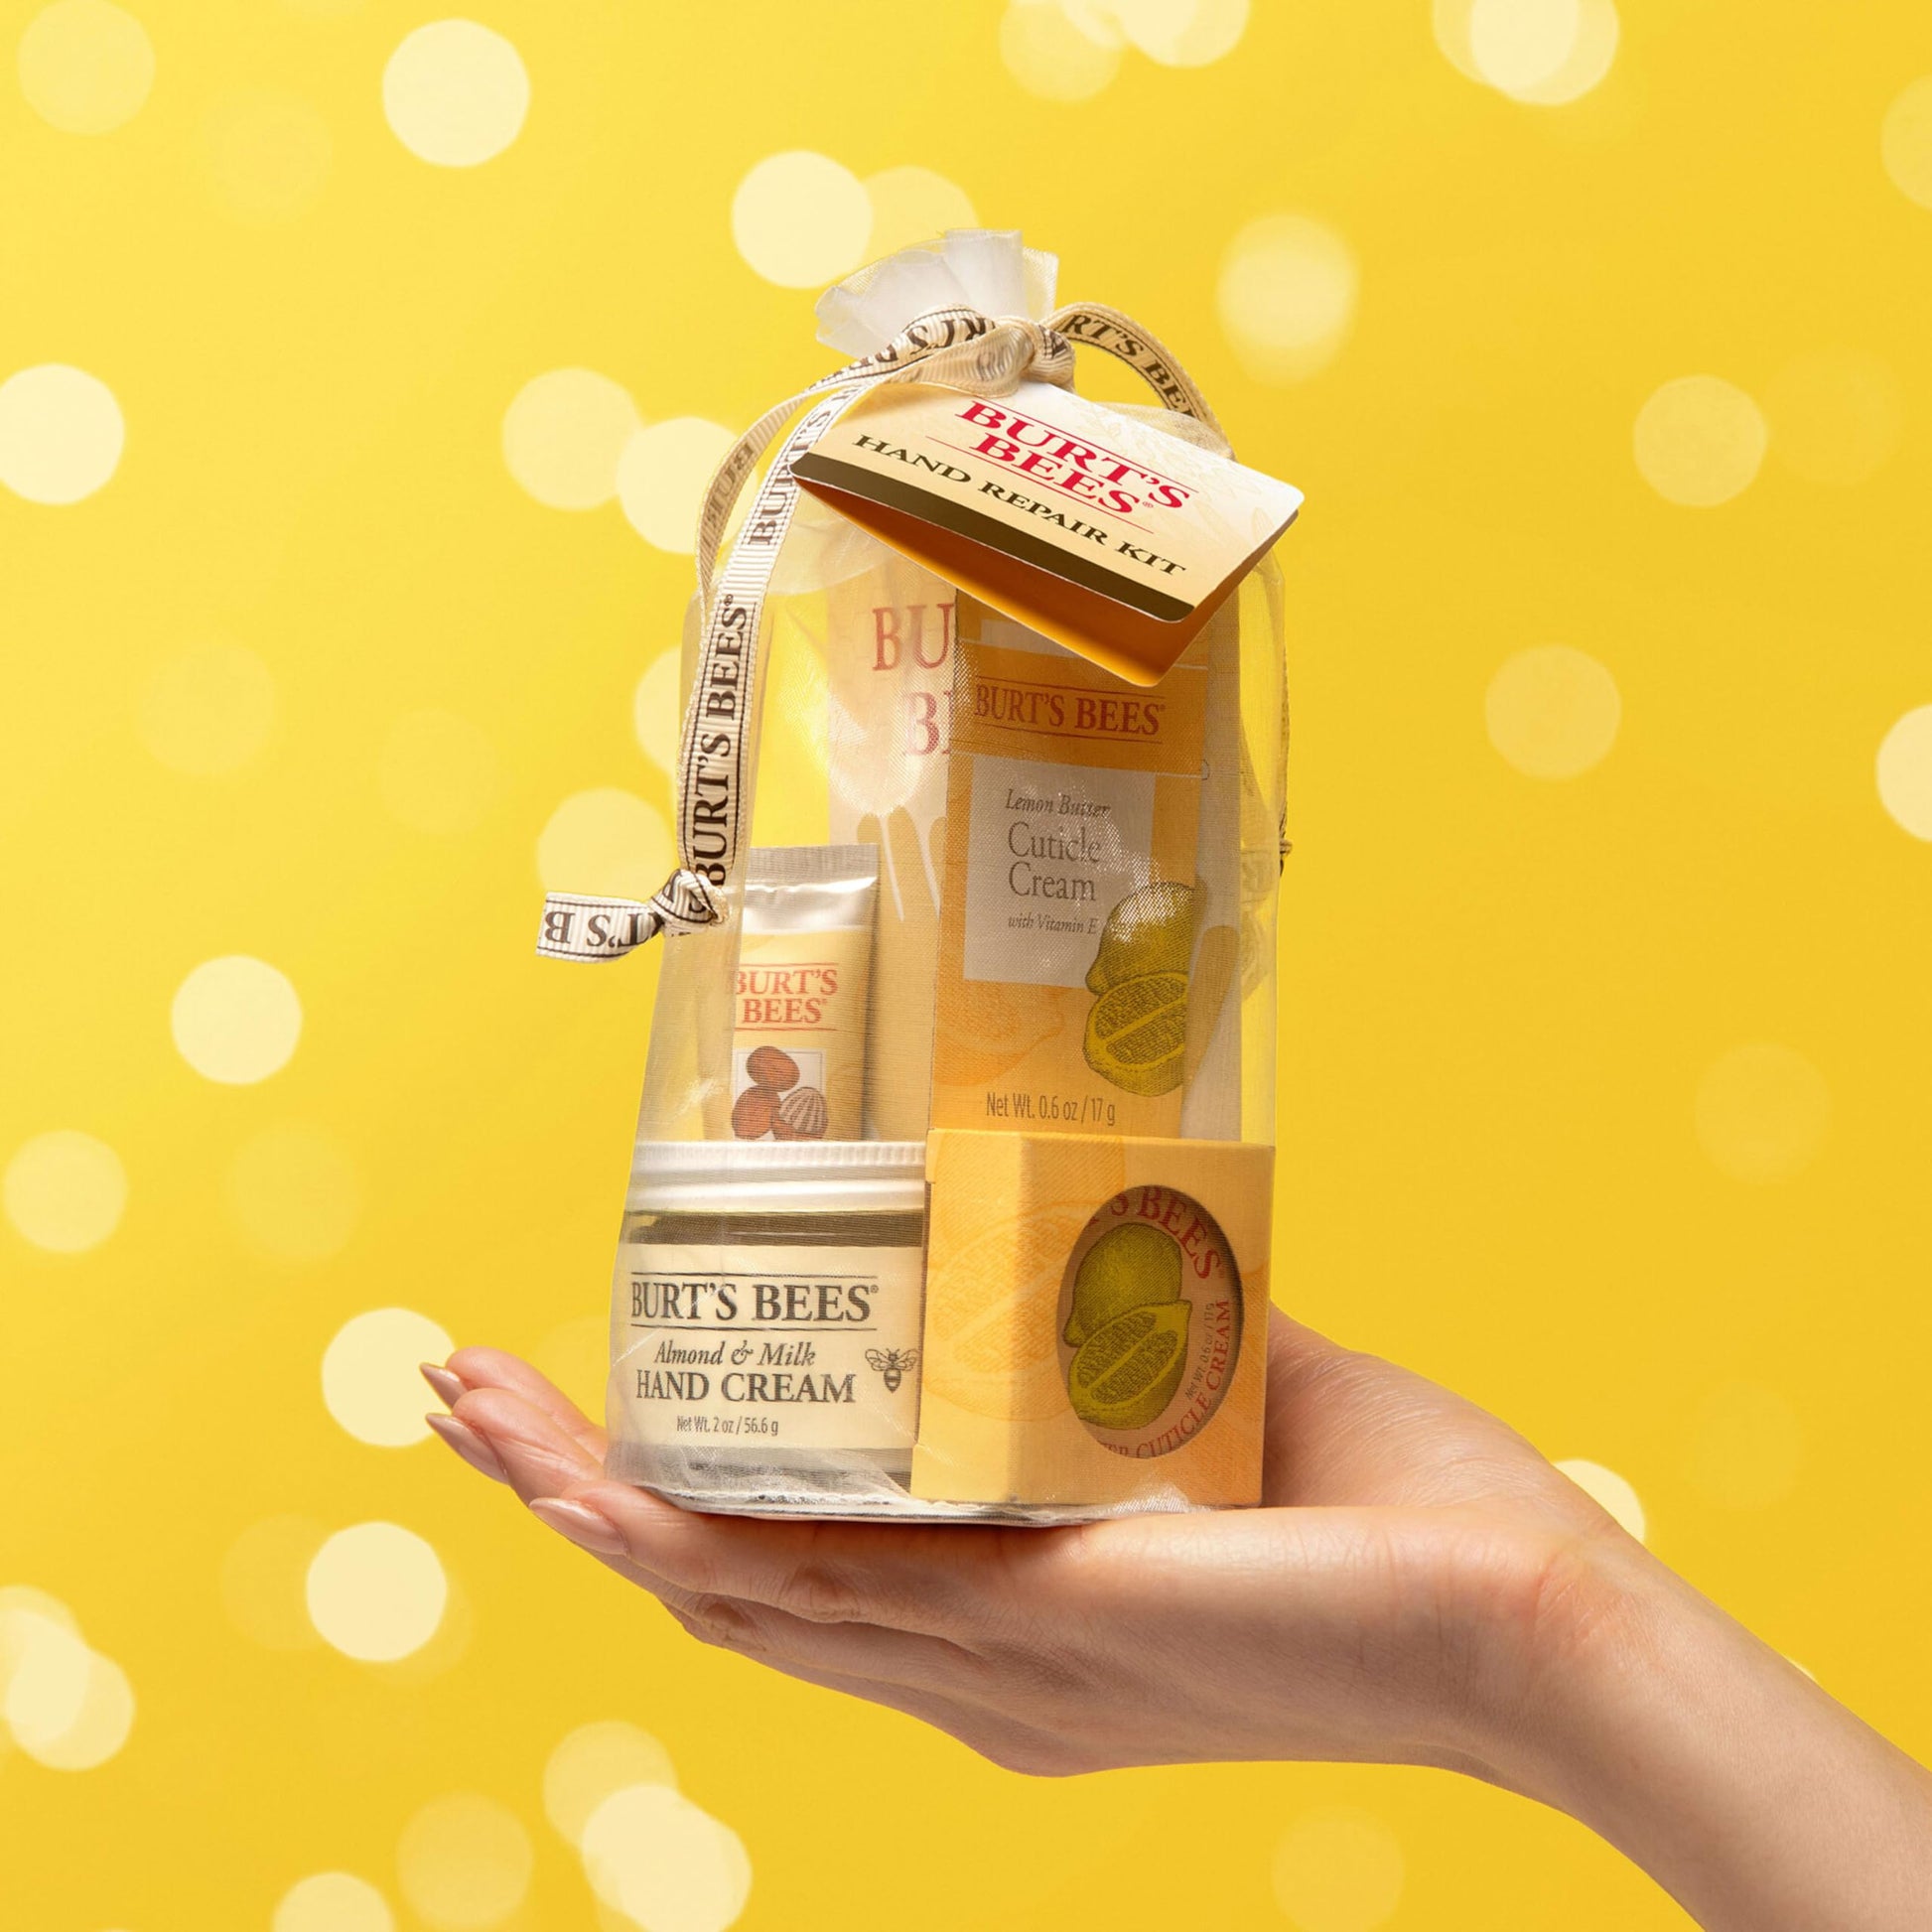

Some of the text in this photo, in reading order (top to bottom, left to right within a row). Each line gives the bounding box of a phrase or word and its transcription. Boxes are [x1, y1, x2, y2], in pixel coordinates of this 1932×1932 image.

[954, 400, 1190, 508] BURT'S
[852, 435, 1186, 578] HAND REPAIR KIT
[974, 683, 1065, 728] BURT'S
[692, 732, 732, 887] BURT'S
[1005, 788, 1111, 818] Lemon Butter
[1008, 821, 1100, 863] Cuticle
[1009, 861, 1096, 901] Cream
[1008, 912, 1099, 934] with Vitamin E
[986, 1092, 1115, 1126] Net Wt. 0.6 oz / 17 g
[631, 1281, 738, 1321] BURT'S
[653, 1339, 816, 1366] Almond & Milk
[636, 1370, 856, 1403] HAND CREAM
[1136, 1299, 1231, 1458] CUTICLE CREAM
[676, 1415, 692, 1432] Net
[713, 1417, 720, 1433] 2
[722, 1421, 734, 1434] oz
[736, 1416, 743, 1436] /
[745, 1417, 767, 1434] 56.6
[771, 1421, 778, 1437] g
